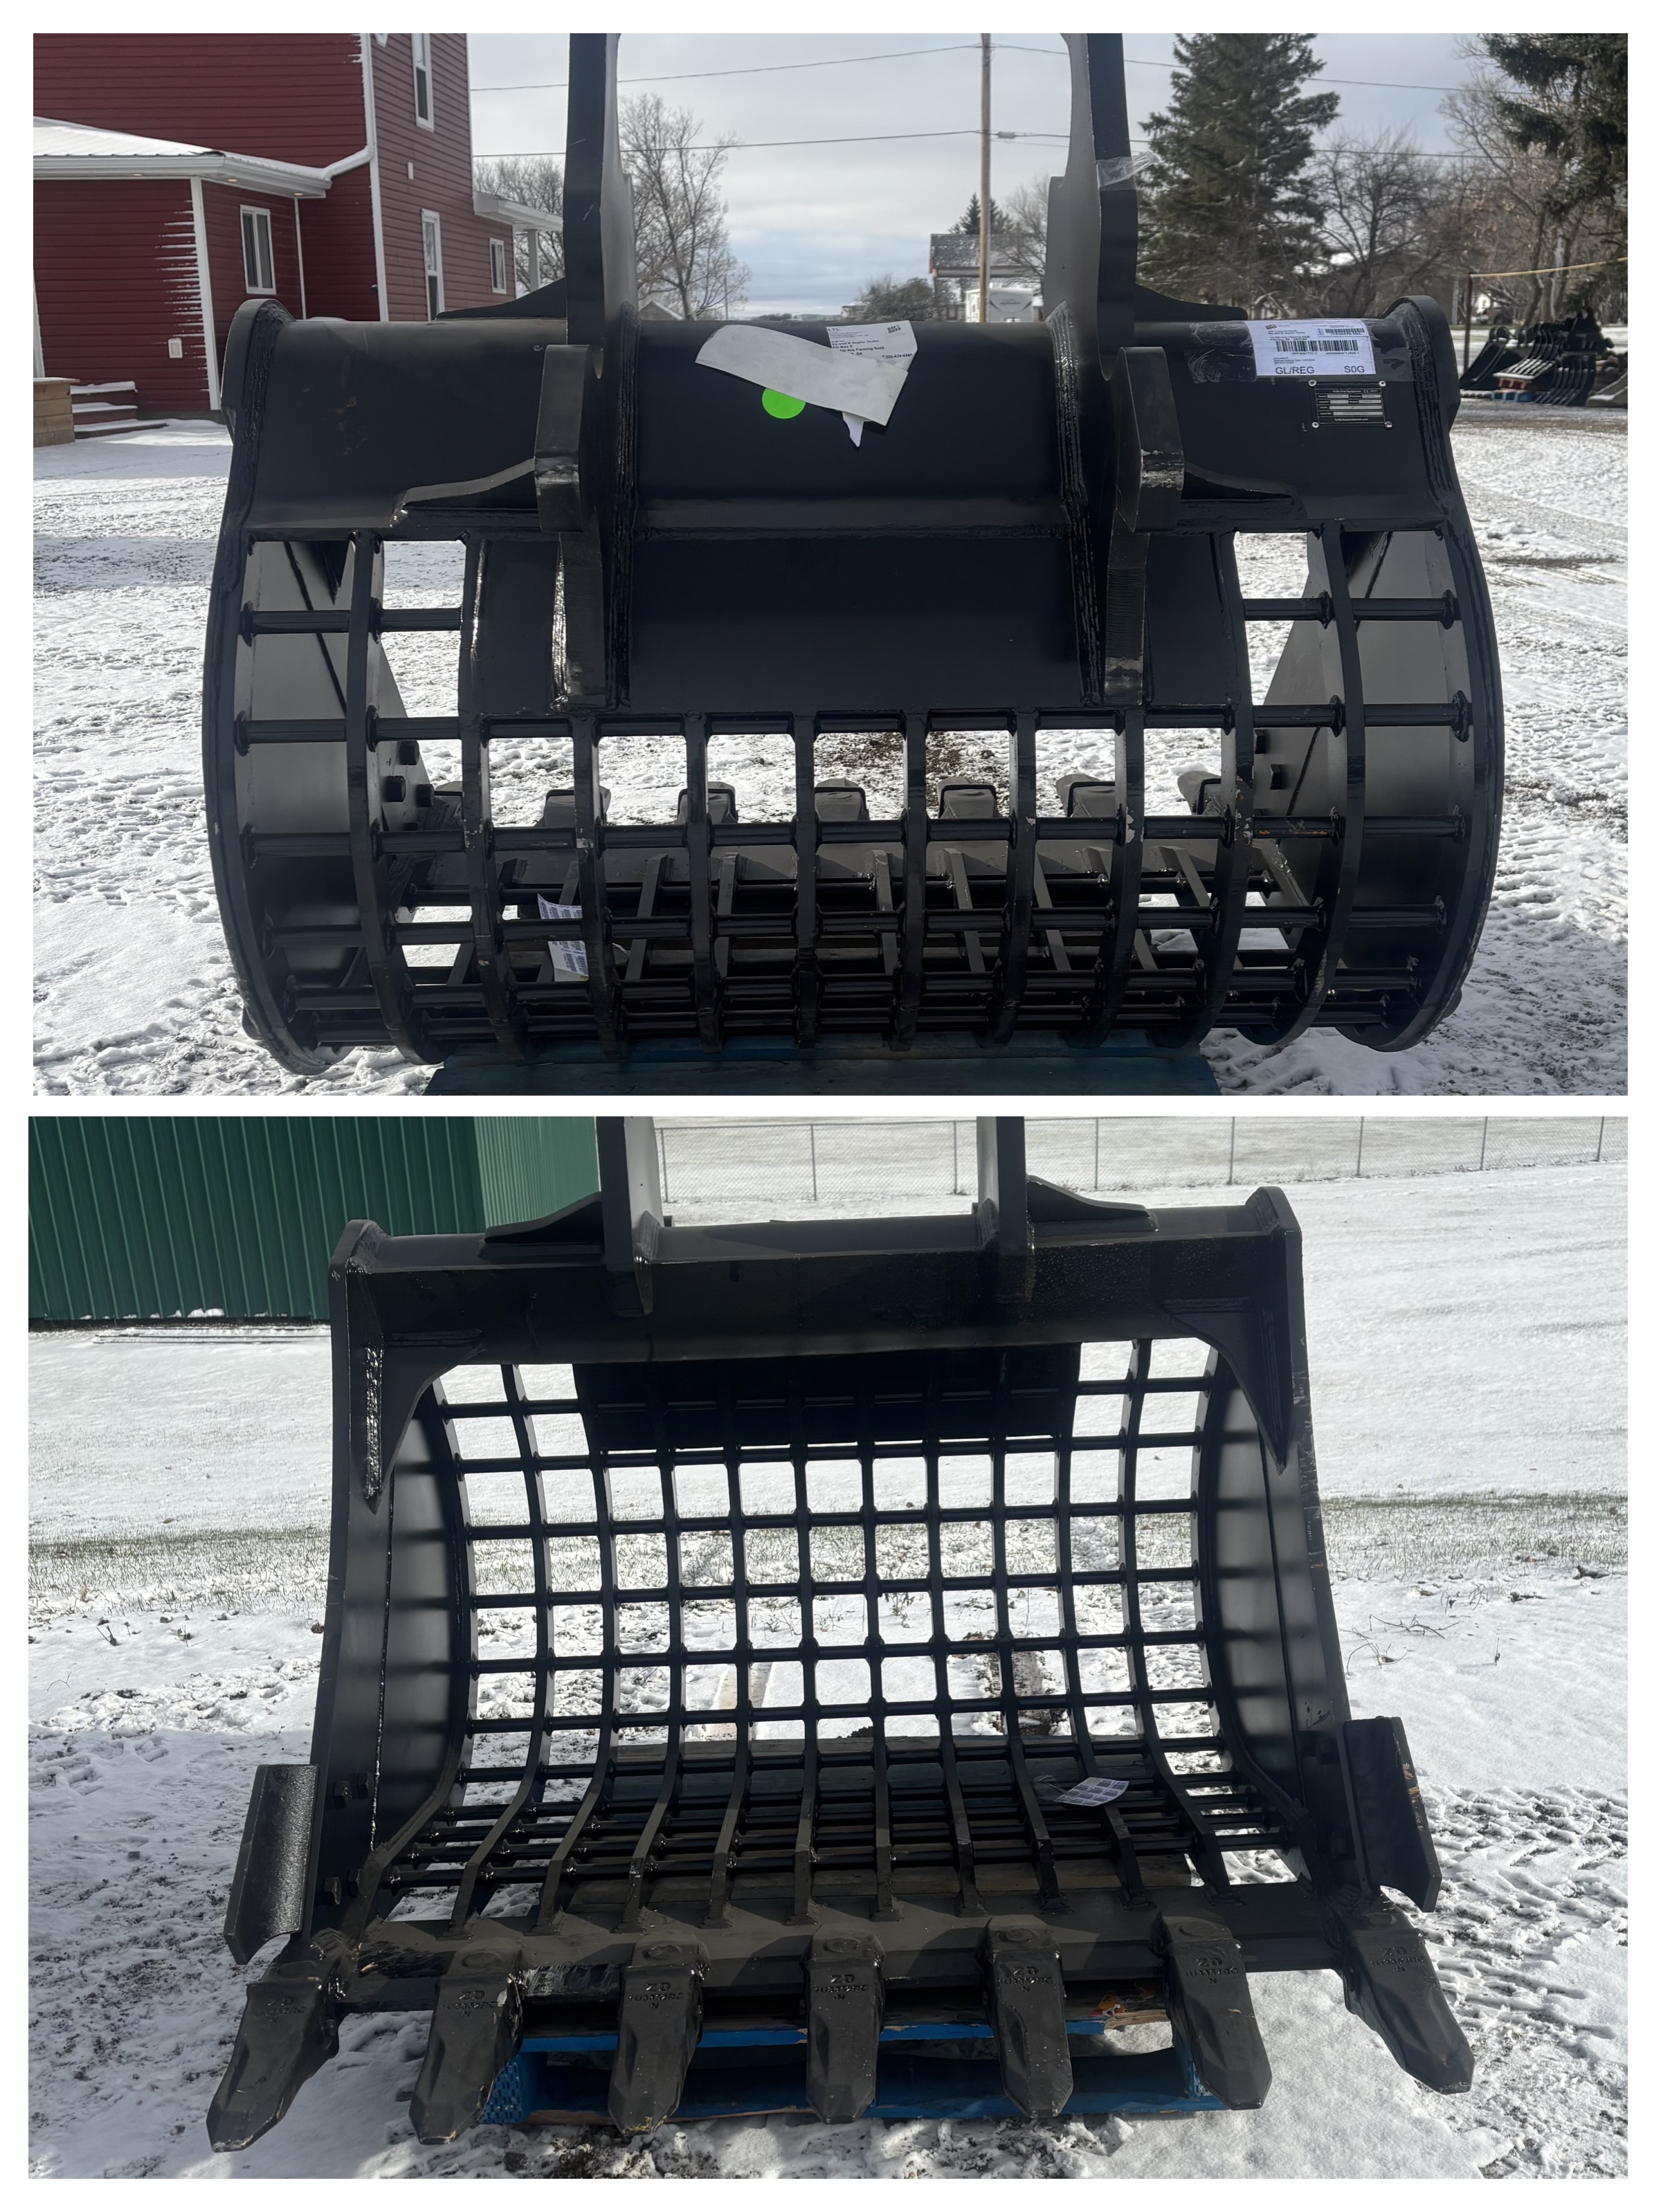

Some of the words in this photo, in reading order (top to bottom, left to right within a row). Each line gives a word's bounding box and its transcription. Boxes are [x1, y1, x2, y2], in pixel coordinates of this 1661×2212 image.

[1276, 366, 1314, 374] GL/REG
[1381, 1946, 1408, 1956] ZD
[1197, 1957, 1222, 1967] ZD
[1013, 1966, 1038, 1975] ZD
[831, 1974, 855, 1984] ZD
[646, 1982, 671, 1991] ZD
[459, 1989, 485, 2000] ZD
